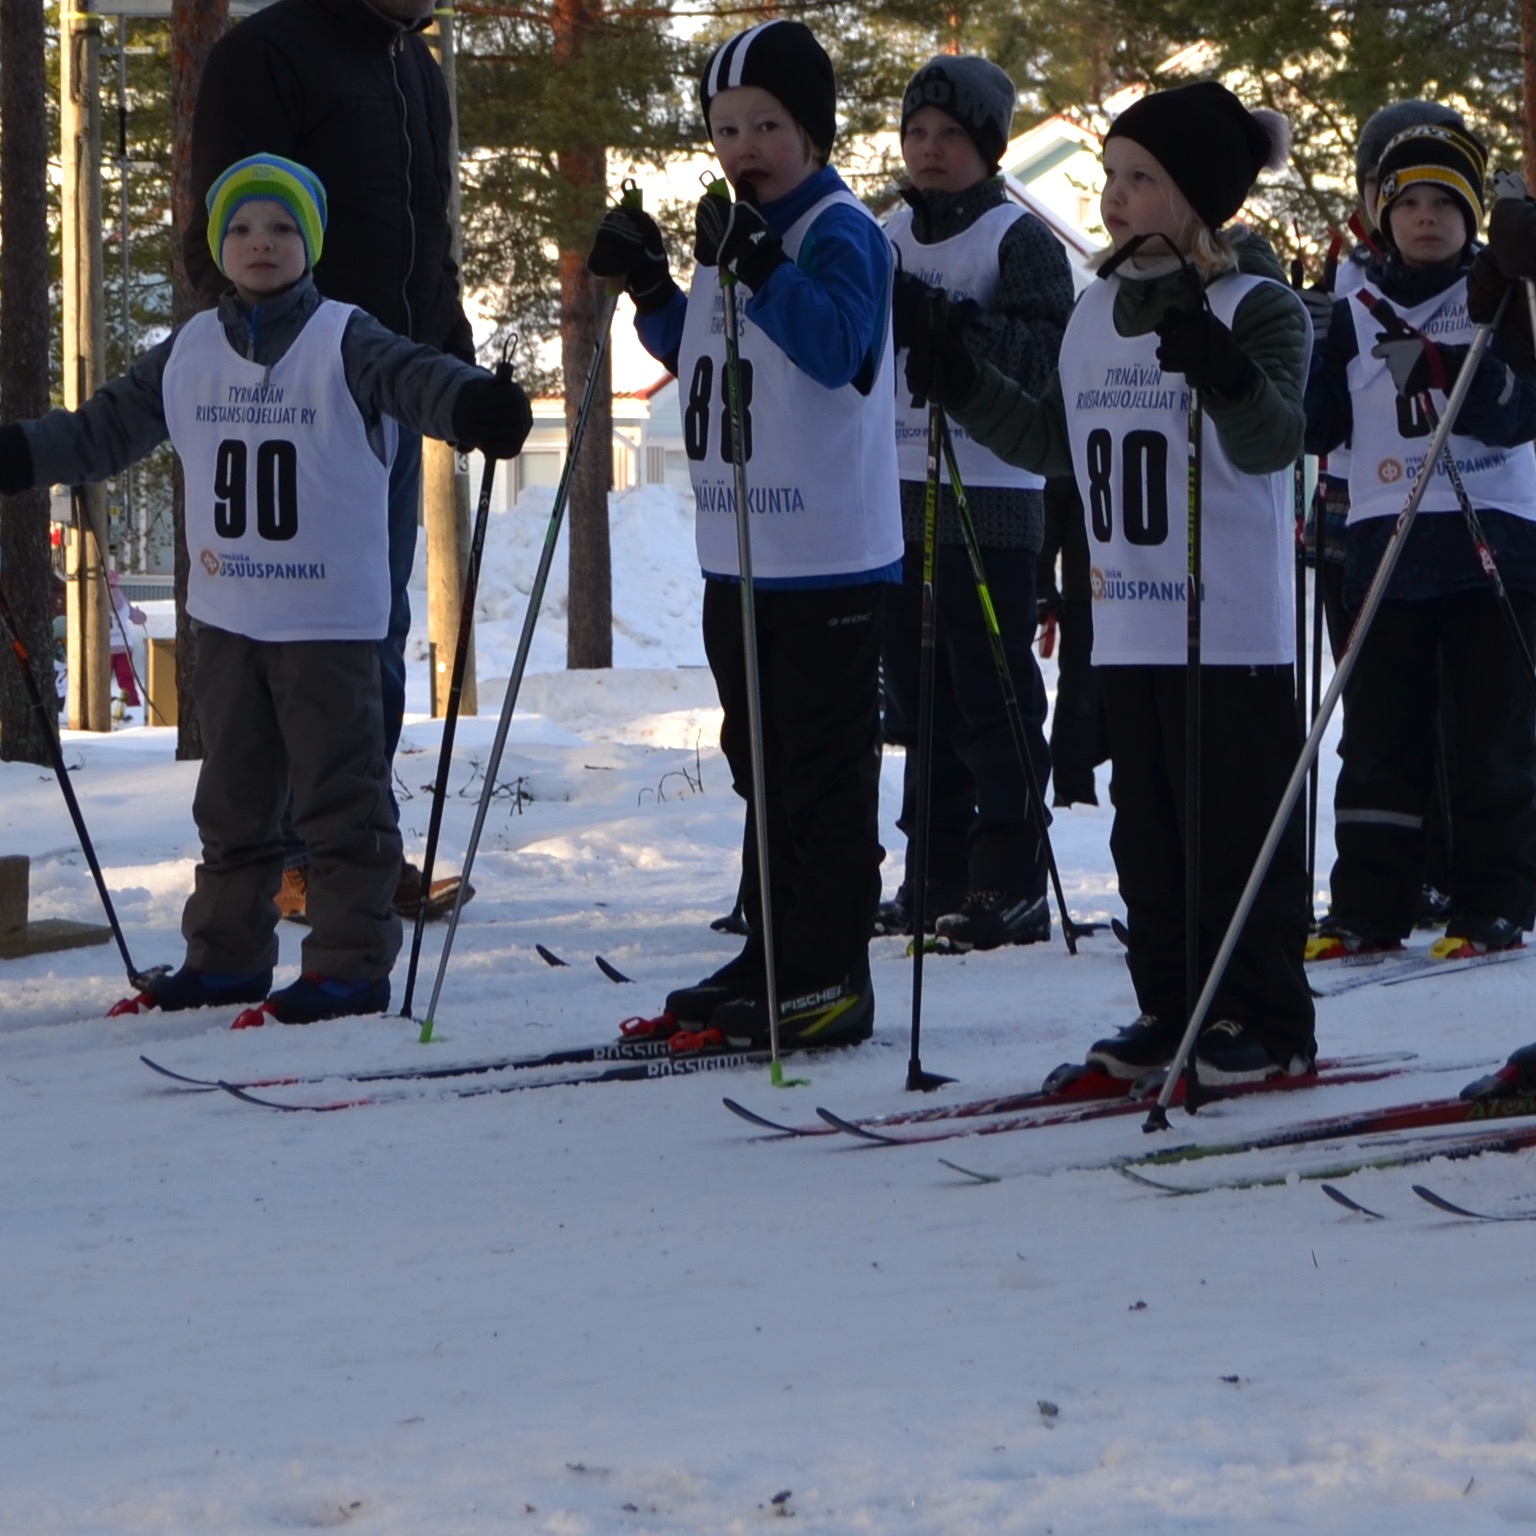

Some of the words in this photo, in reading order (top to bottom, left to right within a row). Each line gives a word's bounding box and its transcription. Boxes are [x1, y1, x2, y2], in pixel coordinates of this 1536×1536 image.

[301, 408, 316, 424] RY
[685, 355, 753, 463] 88
[1104, 363, 1162, 386] TYRNÄVÄN
[215, 439, 298, 541] 90
[1087, 428, 1168, 546] 80
